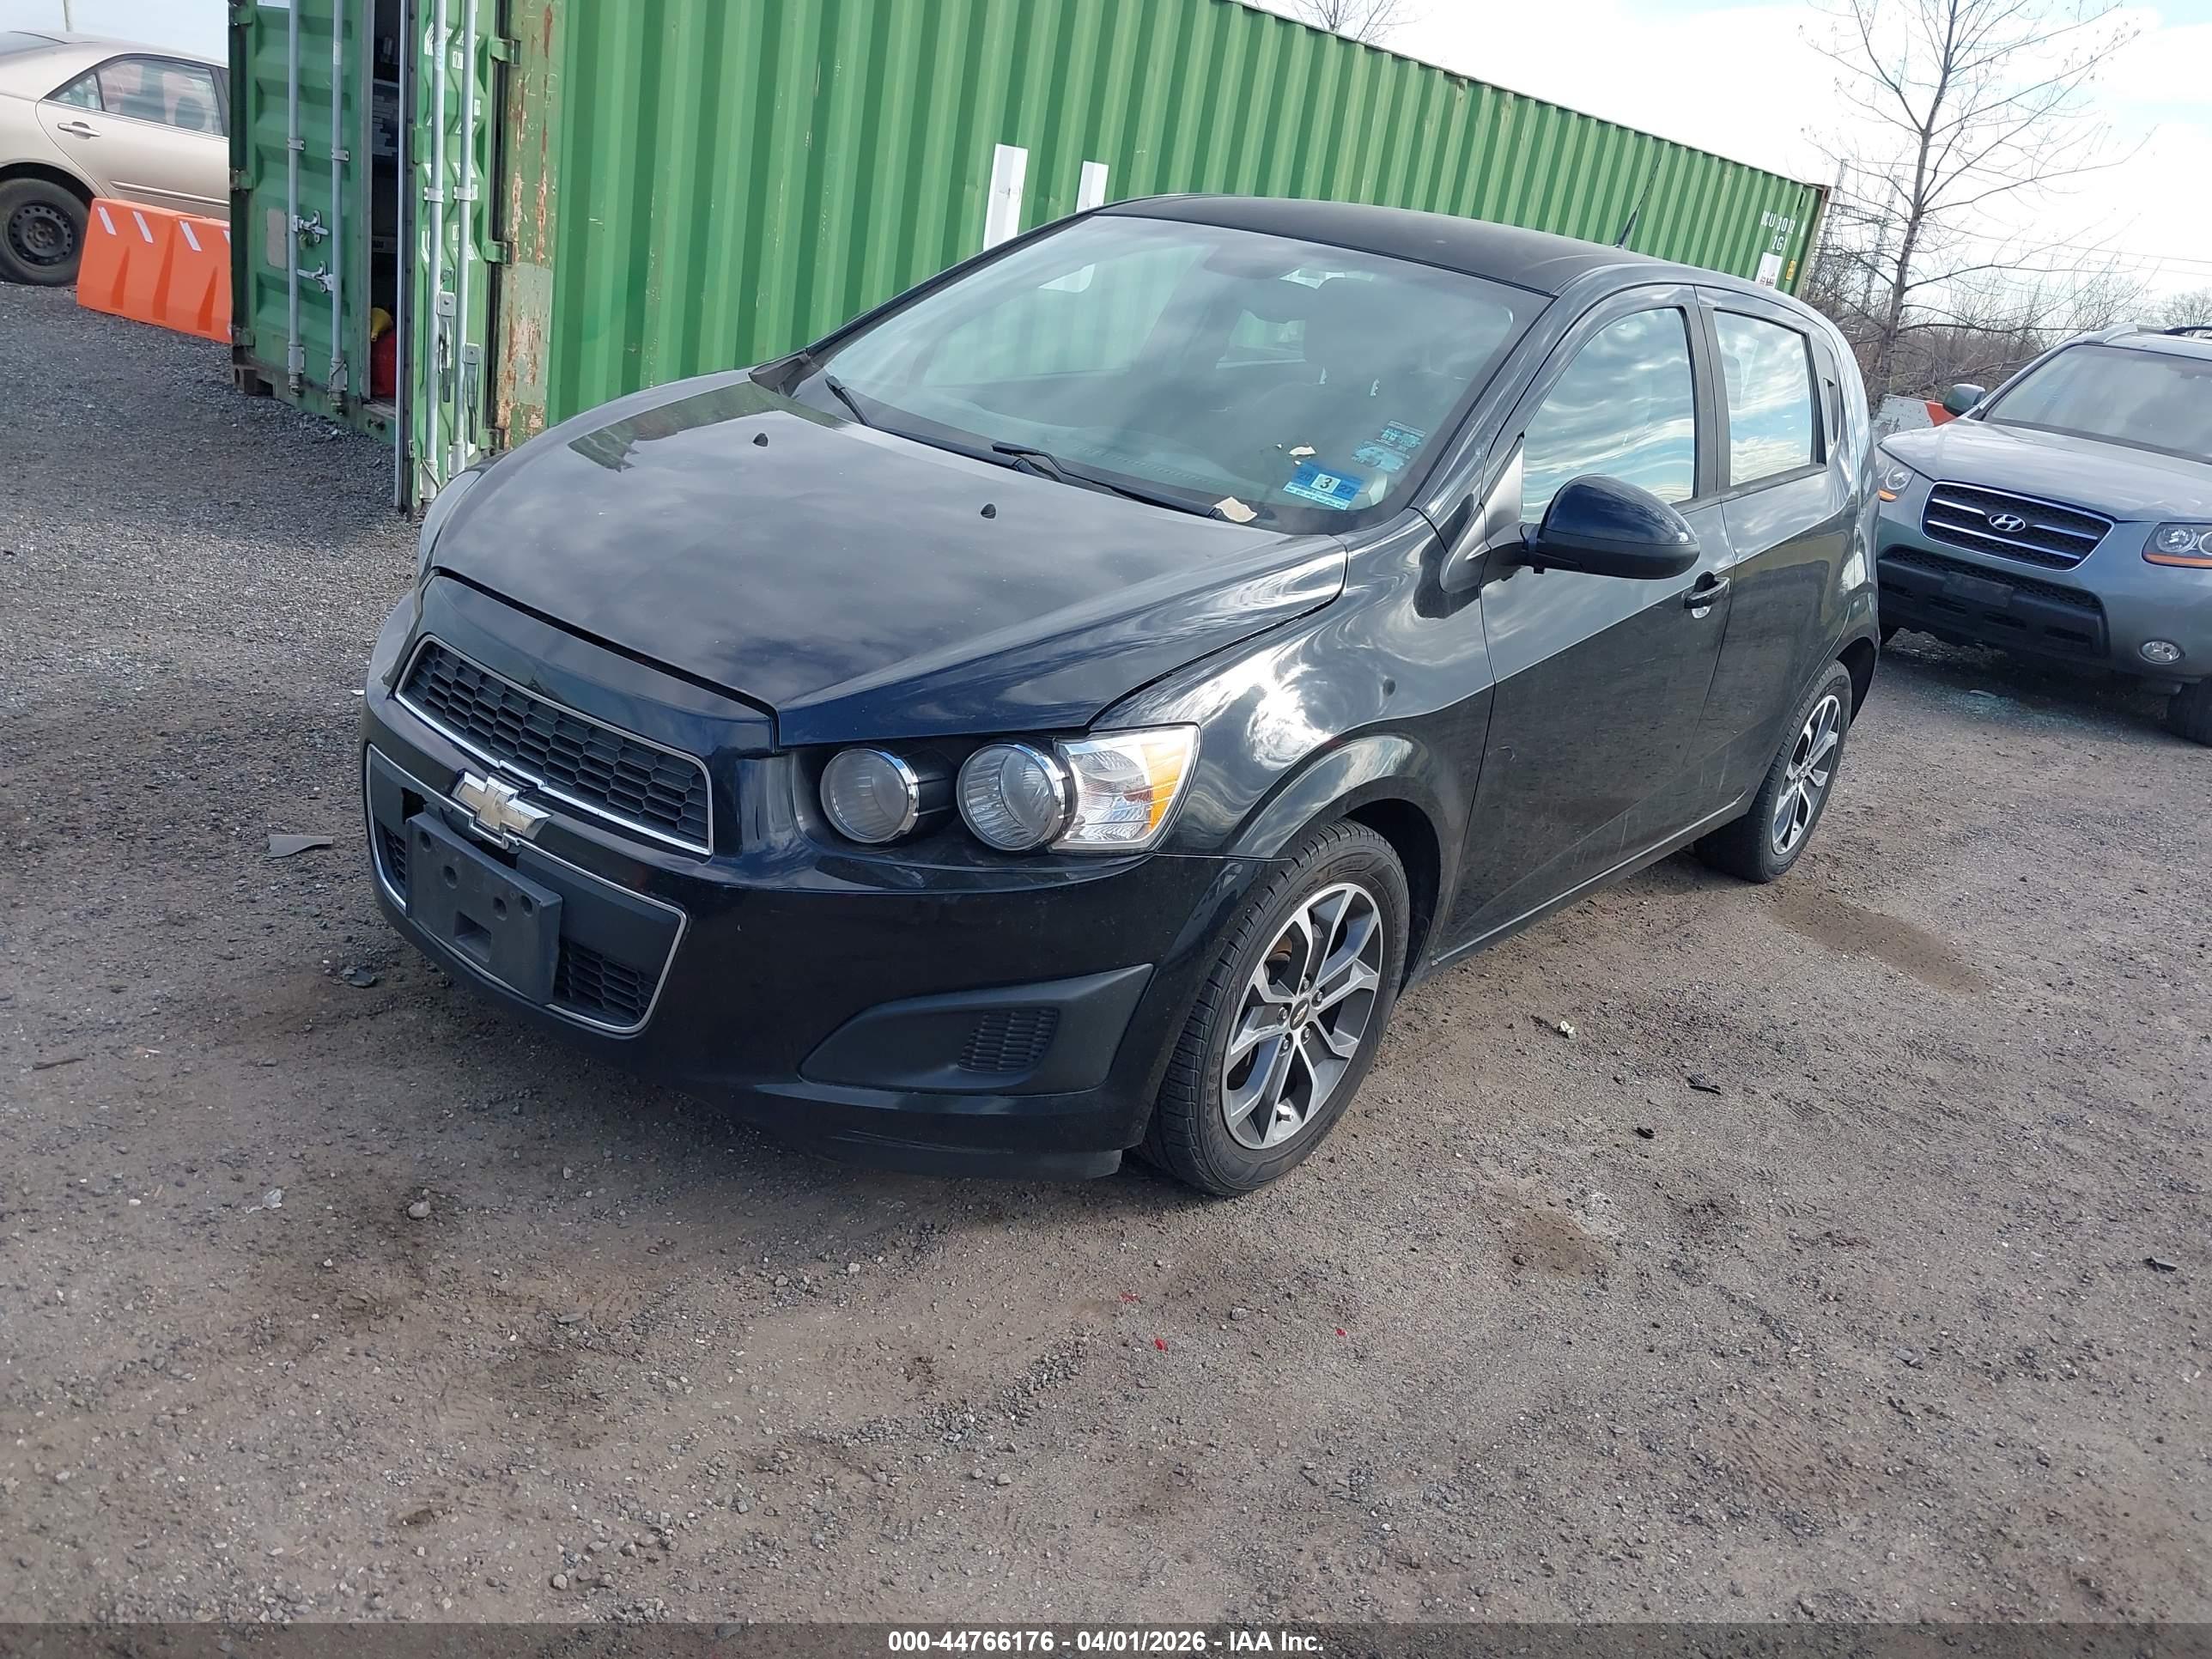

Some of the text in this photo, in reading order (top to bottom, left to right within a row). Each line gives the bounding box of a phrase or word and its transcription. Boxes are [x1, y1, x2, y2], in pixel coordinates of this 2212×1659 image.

[1297, 471, 1355, 495] 20 3 27
